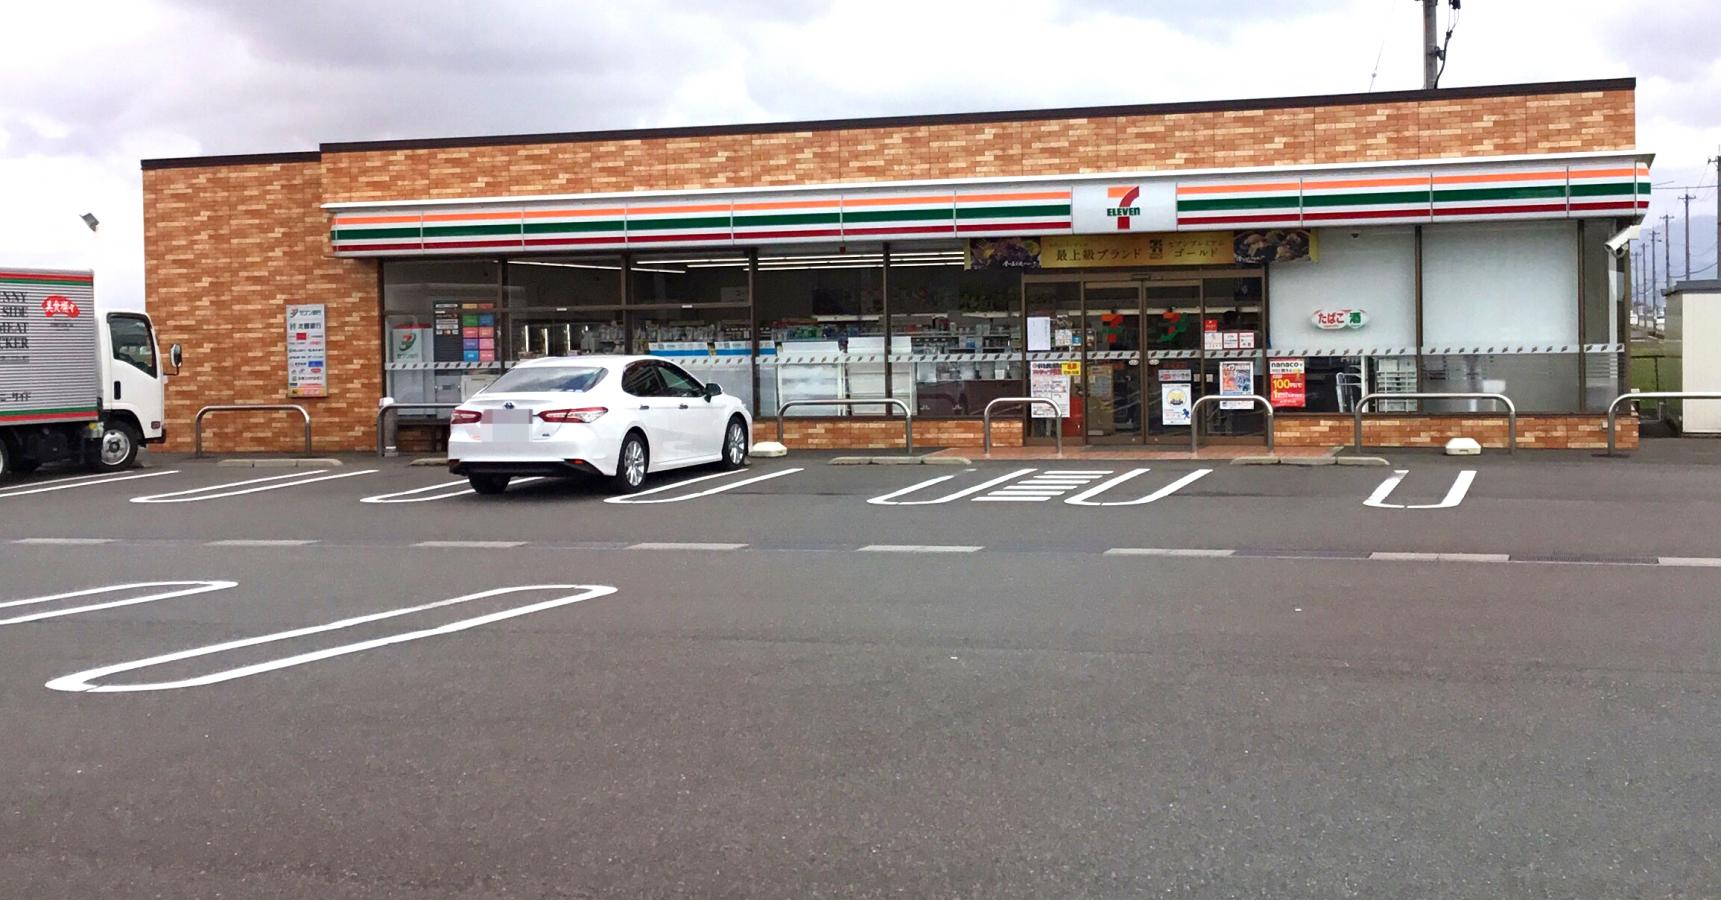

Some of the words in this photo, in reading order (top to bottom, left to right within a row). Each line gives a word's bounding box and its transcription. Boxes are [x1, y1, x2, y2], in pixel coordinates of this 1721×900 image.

[1107, 185, 1140, 230] 7
[1056, 248, 1141, 261] 最上級ブランド
[1174, 248, 1218, 257] ゴールド
[1318, 312, 1345, 324] たばこ
